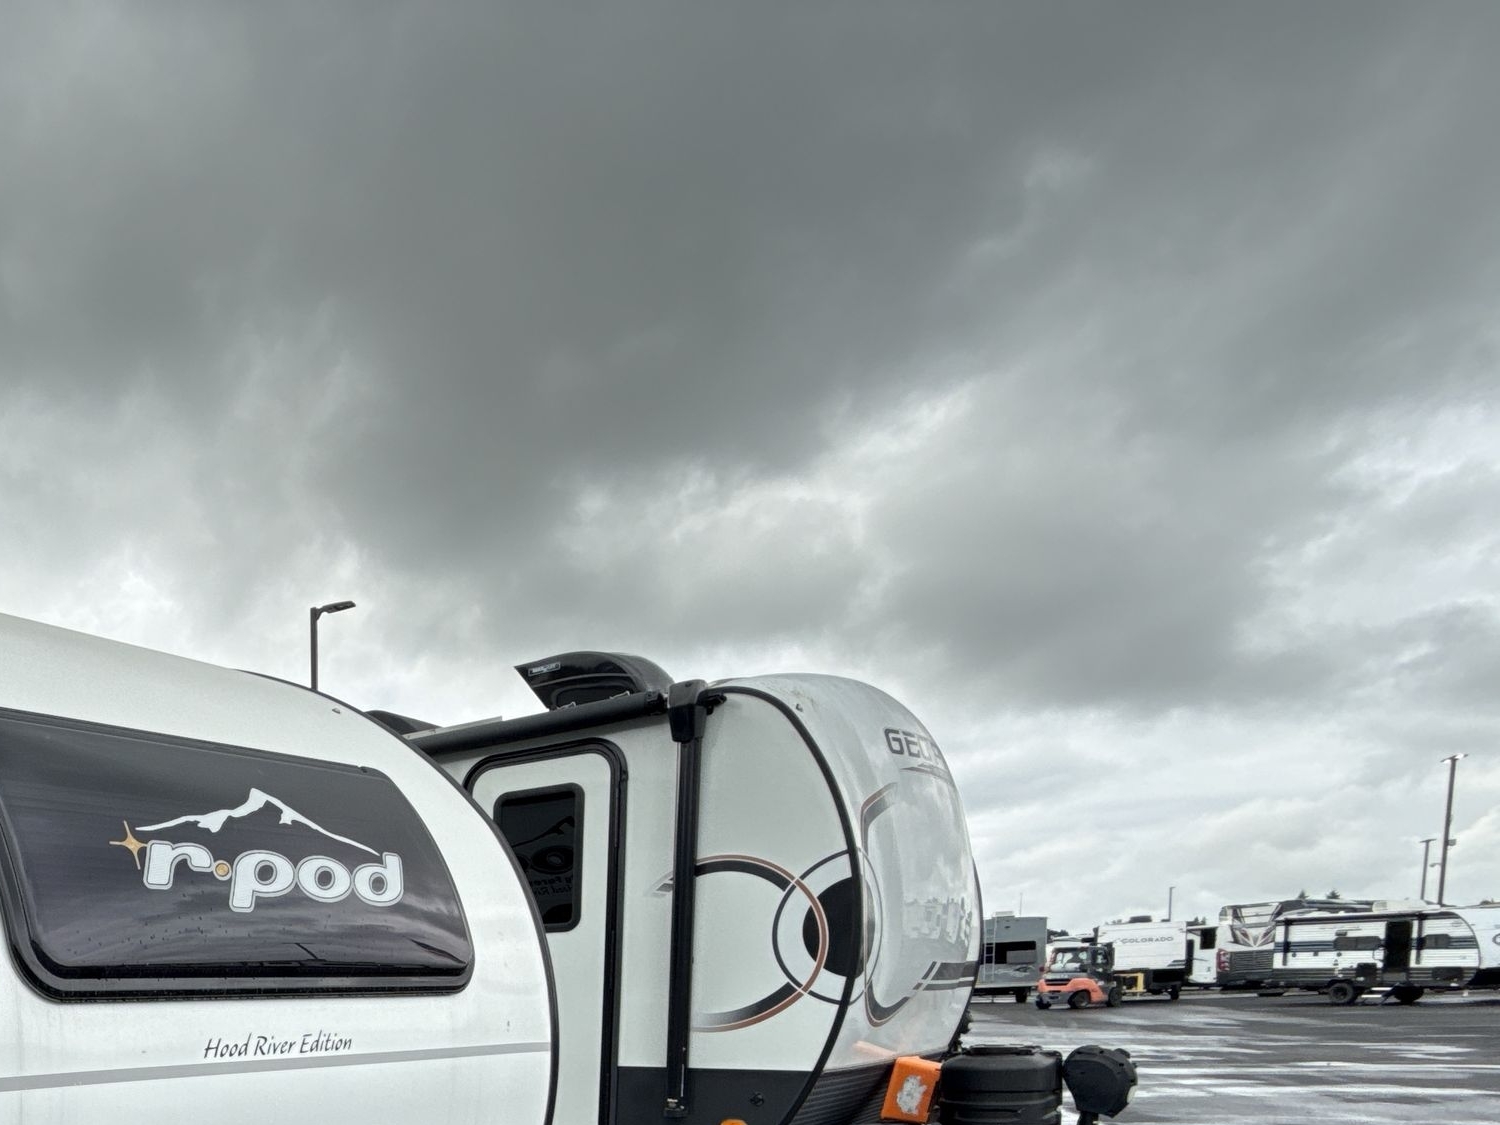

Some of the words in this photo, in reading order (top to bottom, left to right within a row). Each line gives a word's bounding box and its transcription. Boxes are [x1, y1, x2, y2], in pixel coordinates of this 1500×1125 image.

[1120, 936, 1174, 944] COLORADO
[204, 1033, 249, 1059] Hood
[254, 1034, 296, 1056] River
[300, 1030, 352, 1053] Edition
